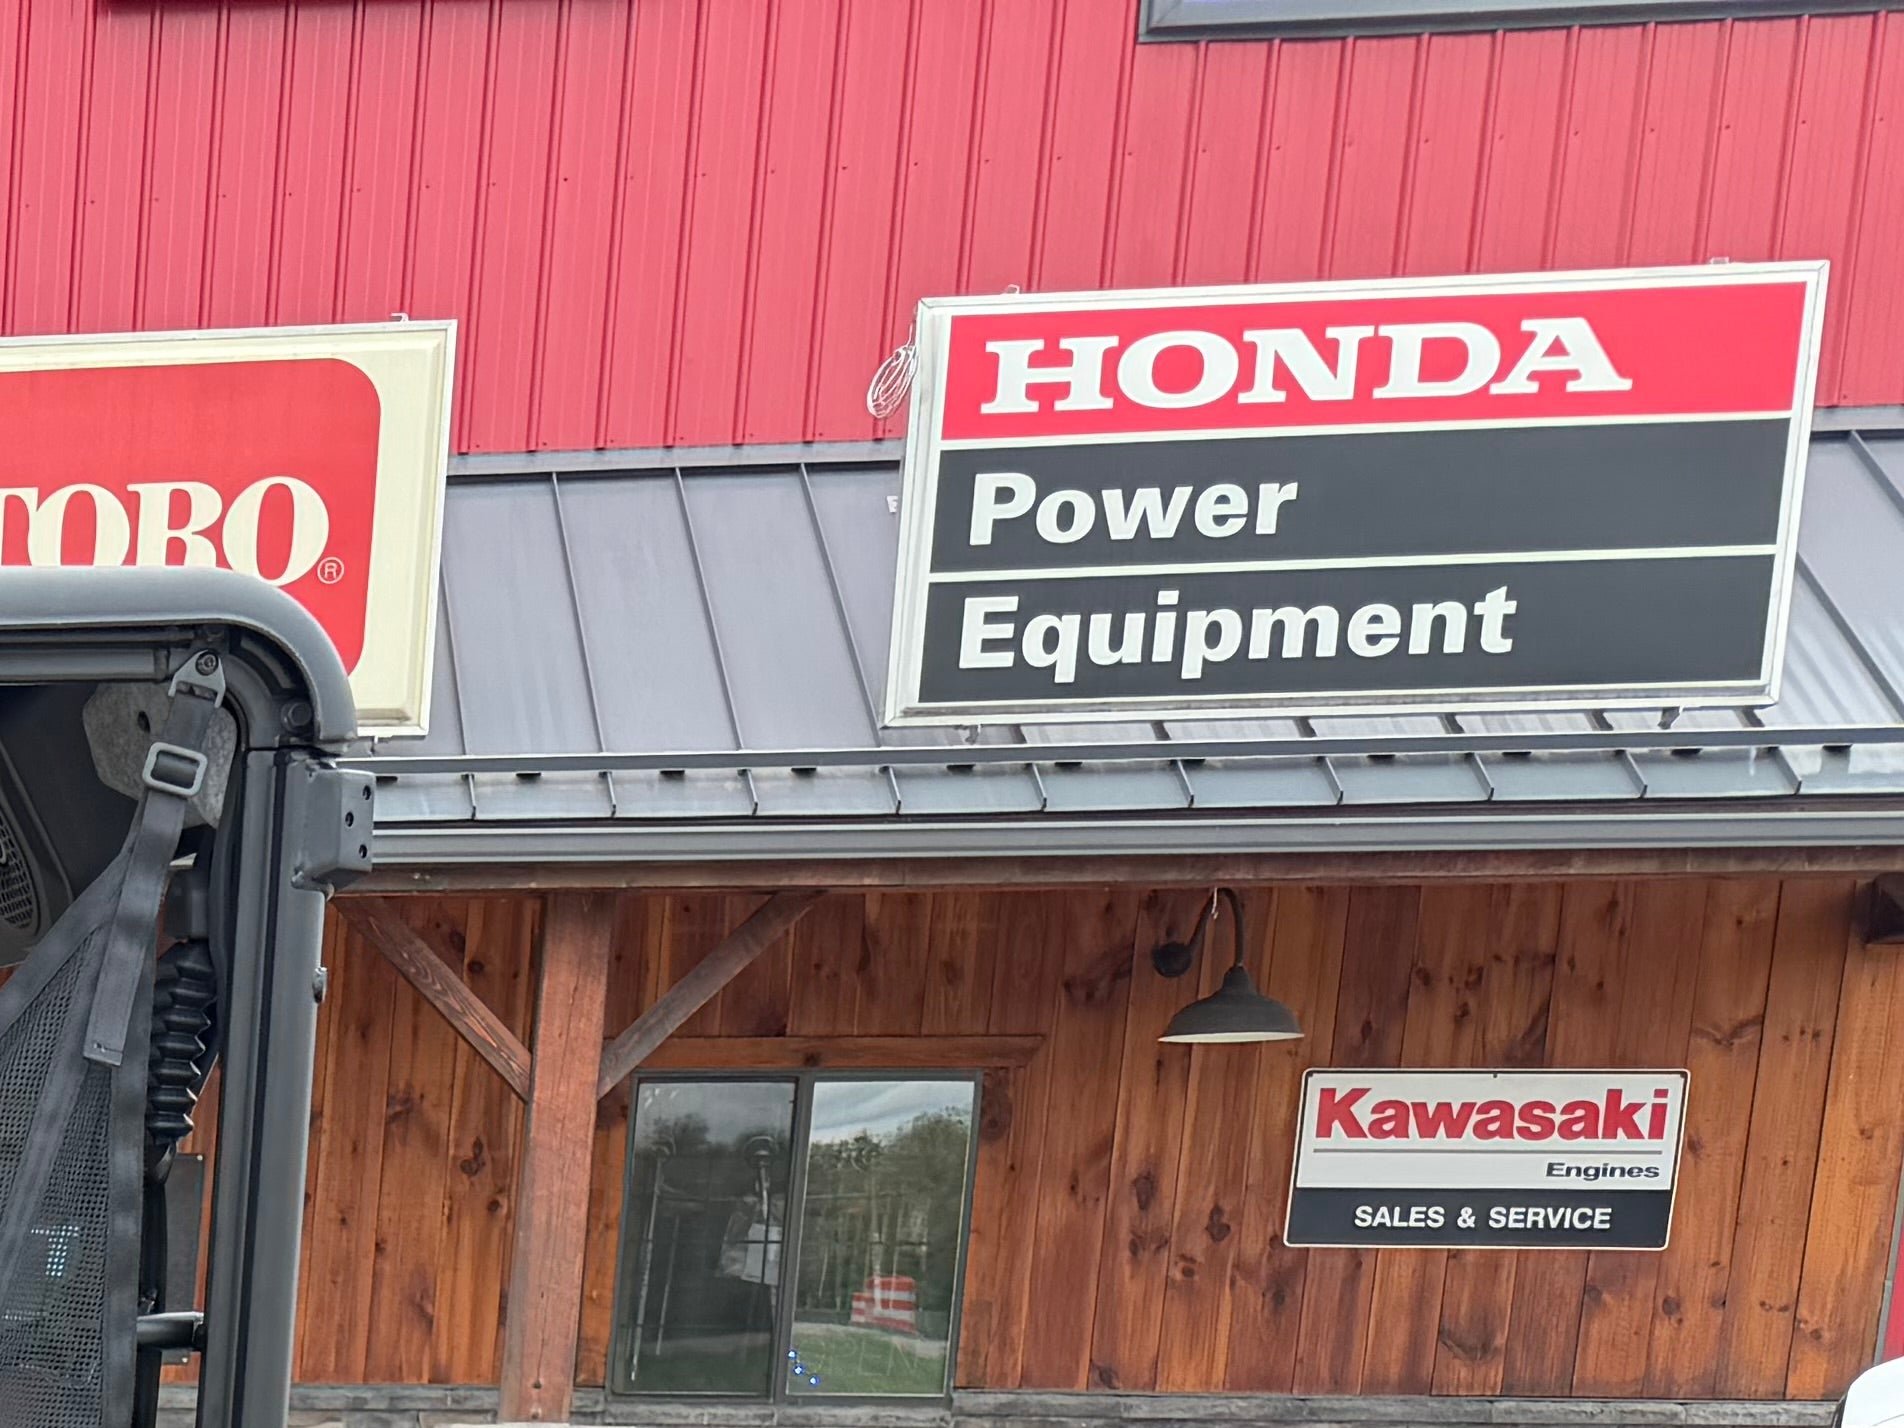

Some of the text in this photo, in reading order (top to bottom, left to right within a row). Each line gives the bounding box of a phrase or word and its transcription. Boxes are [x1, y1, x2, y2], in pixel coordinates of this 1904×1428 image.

[980, 317, 1632, 414] HONDA
[968, 473, 1299, 547] Power
[958, 586, 1518, 684] Equipment
[1315, 1088, 1669, 1141] Kawasaki
[1545, 1162, 1660, 1181] Engines
[1354, 1206, 1612, 1230] SALES & SERVICE
